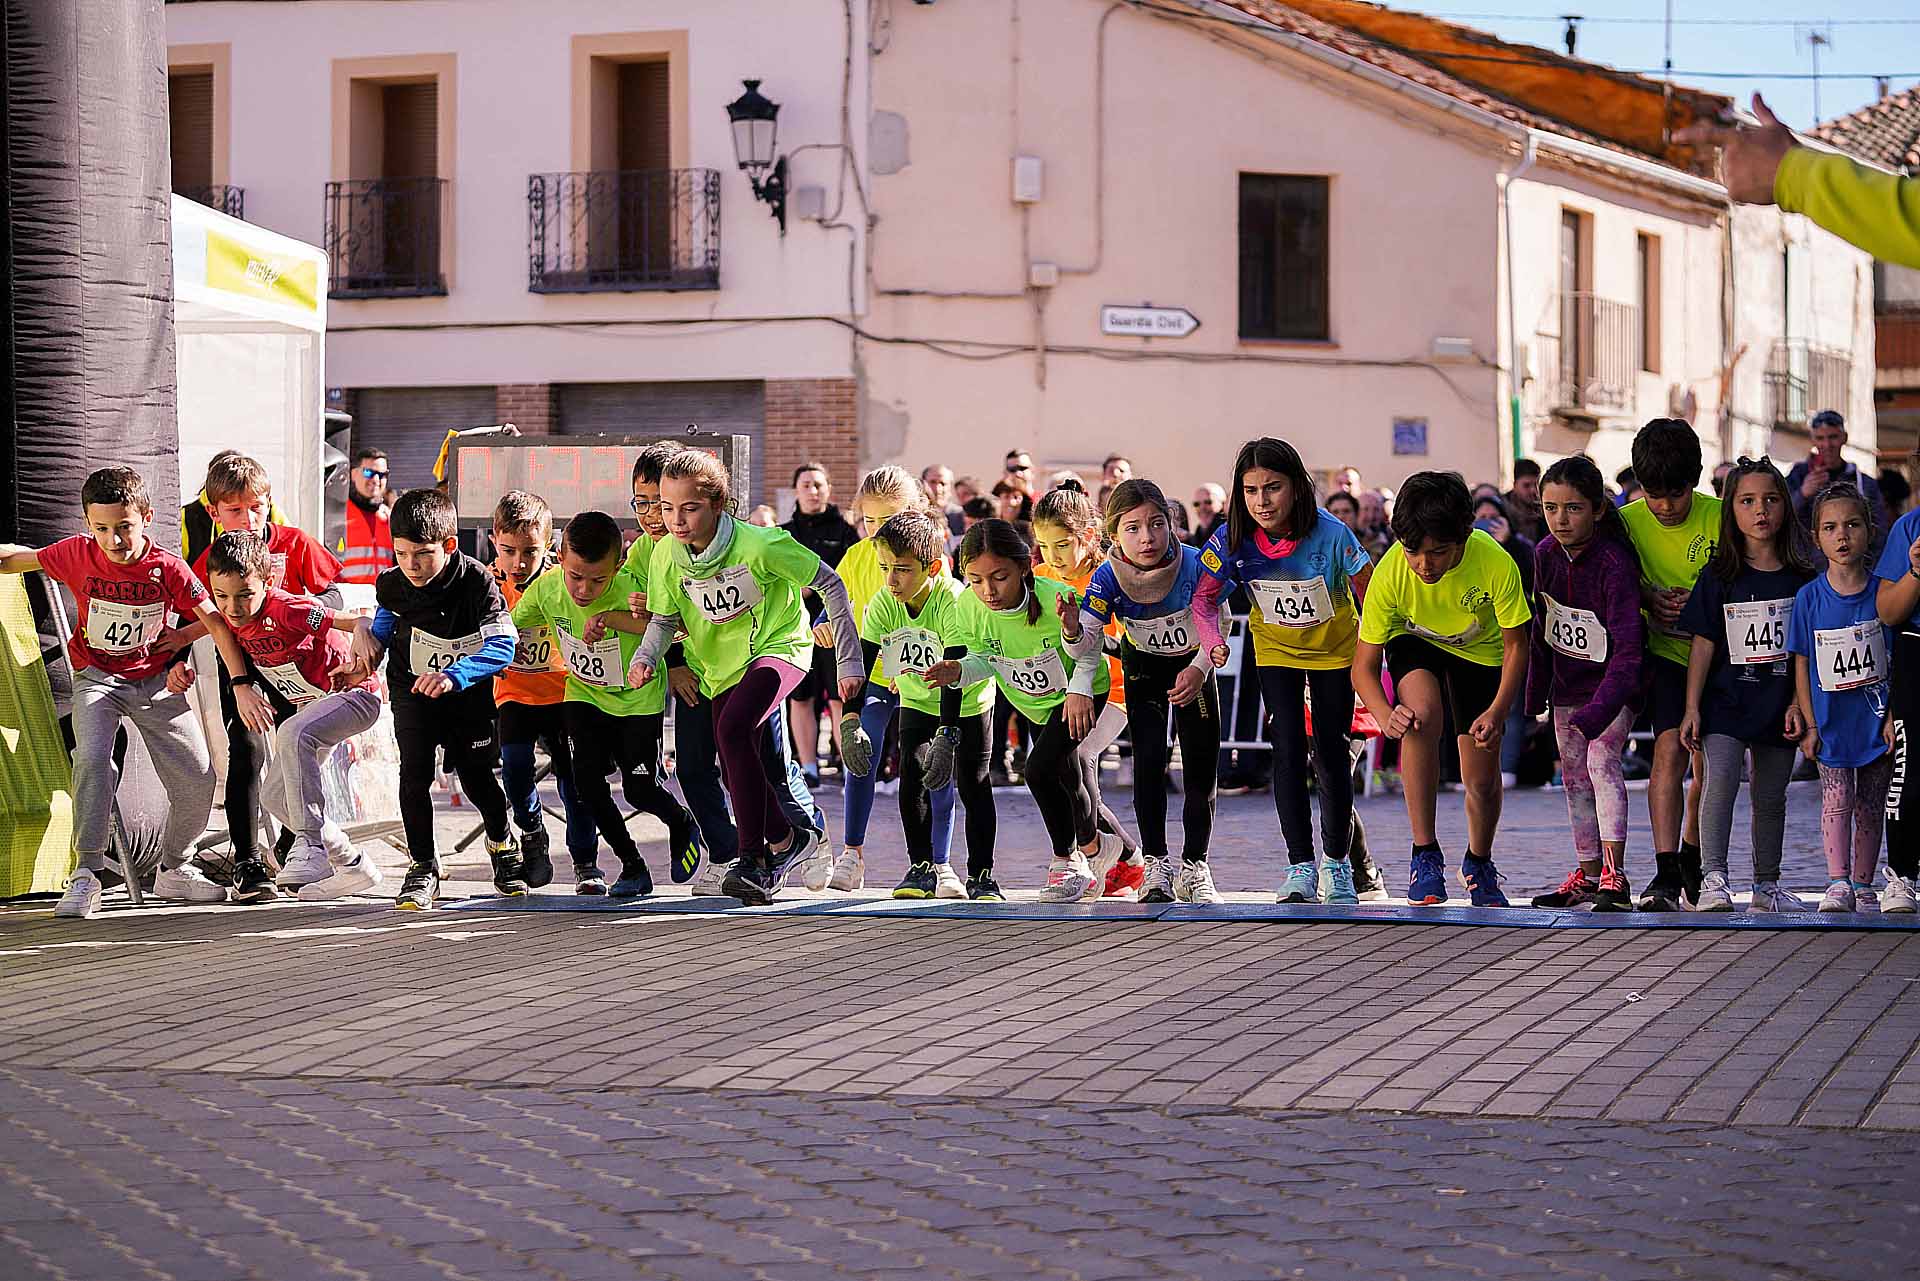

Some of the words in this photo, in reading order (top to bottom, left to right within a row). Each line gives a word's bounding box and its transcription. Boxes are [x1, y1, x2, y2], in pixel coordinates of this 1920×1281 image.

[83, 577, 161, 600] MARIO
[703, 585, 745, 616] 442
[1274, 596, 1316, 620] 434
[104, 622, 144, 646] 421
[1147, 627, 1188, 650] 440
[1551, 619, 1588, 650] 438
[1744, 620, 1785, 652] 445
[519, 641, 550, 665] 30
[570, 651, 605, 678] 428
[899, 642, 935, 668] 426
[1833, 644, 1876, 678] 444
[1012, 669, 1049, 691] 439
[1886, 719, 1907, 821] ATTITUDE
